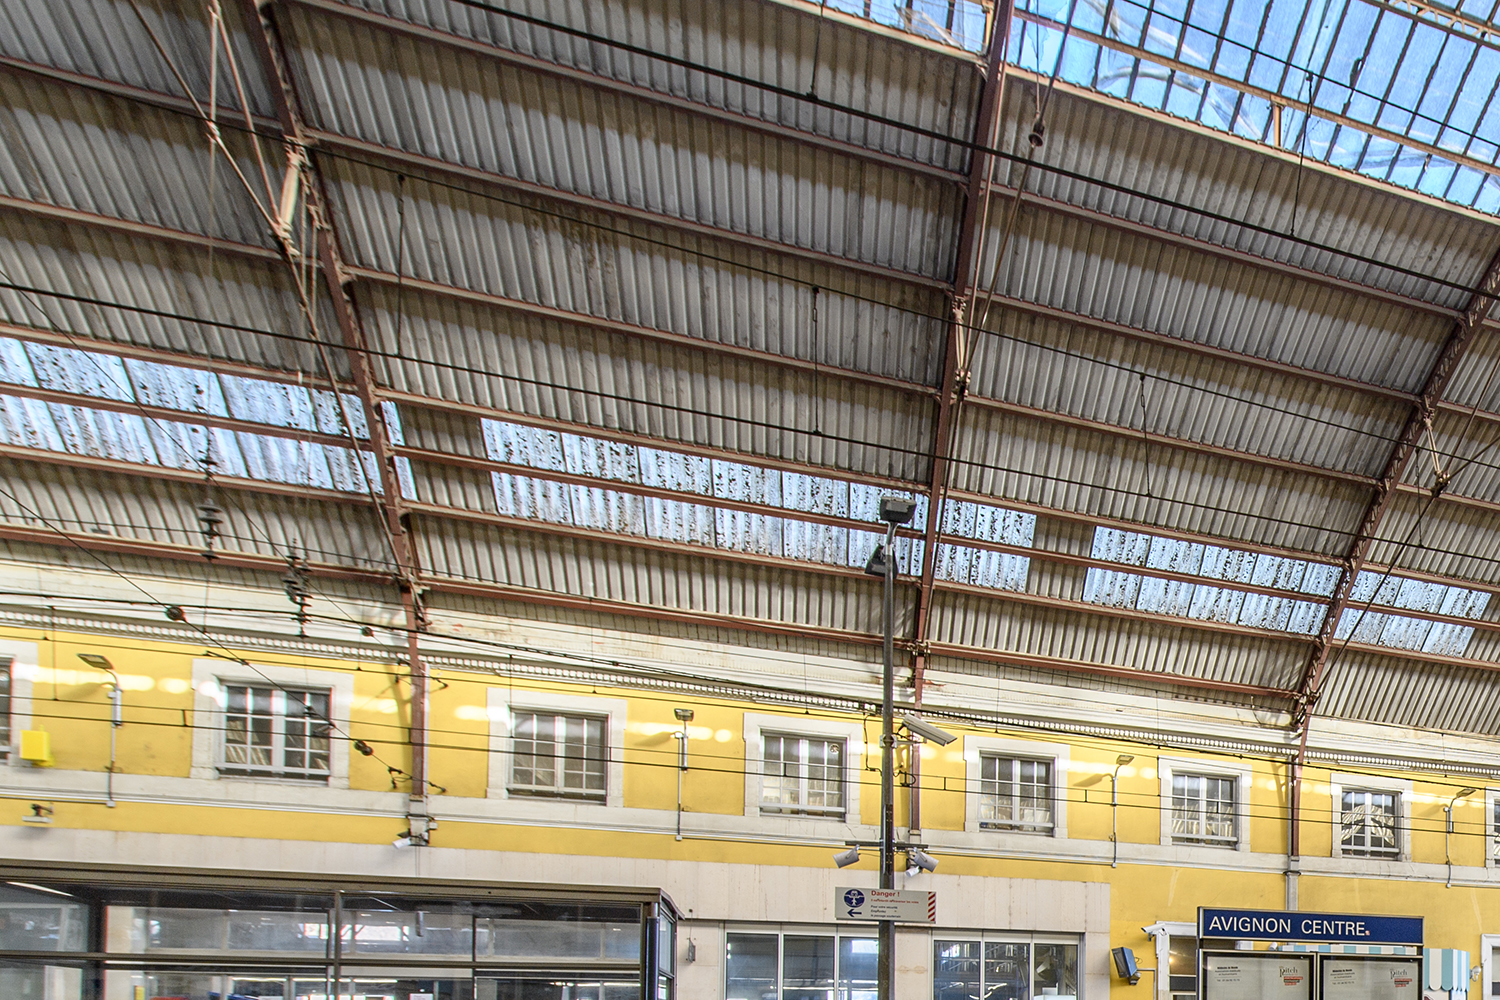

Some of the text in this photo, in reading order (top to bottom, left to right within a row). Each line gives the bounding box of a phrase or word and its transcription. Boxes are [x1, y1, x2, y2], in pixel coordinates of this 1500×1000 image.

[871, 890, 895, 898] Danger
[1209, 916, 1366, 936] AVIGNON CENTRE
